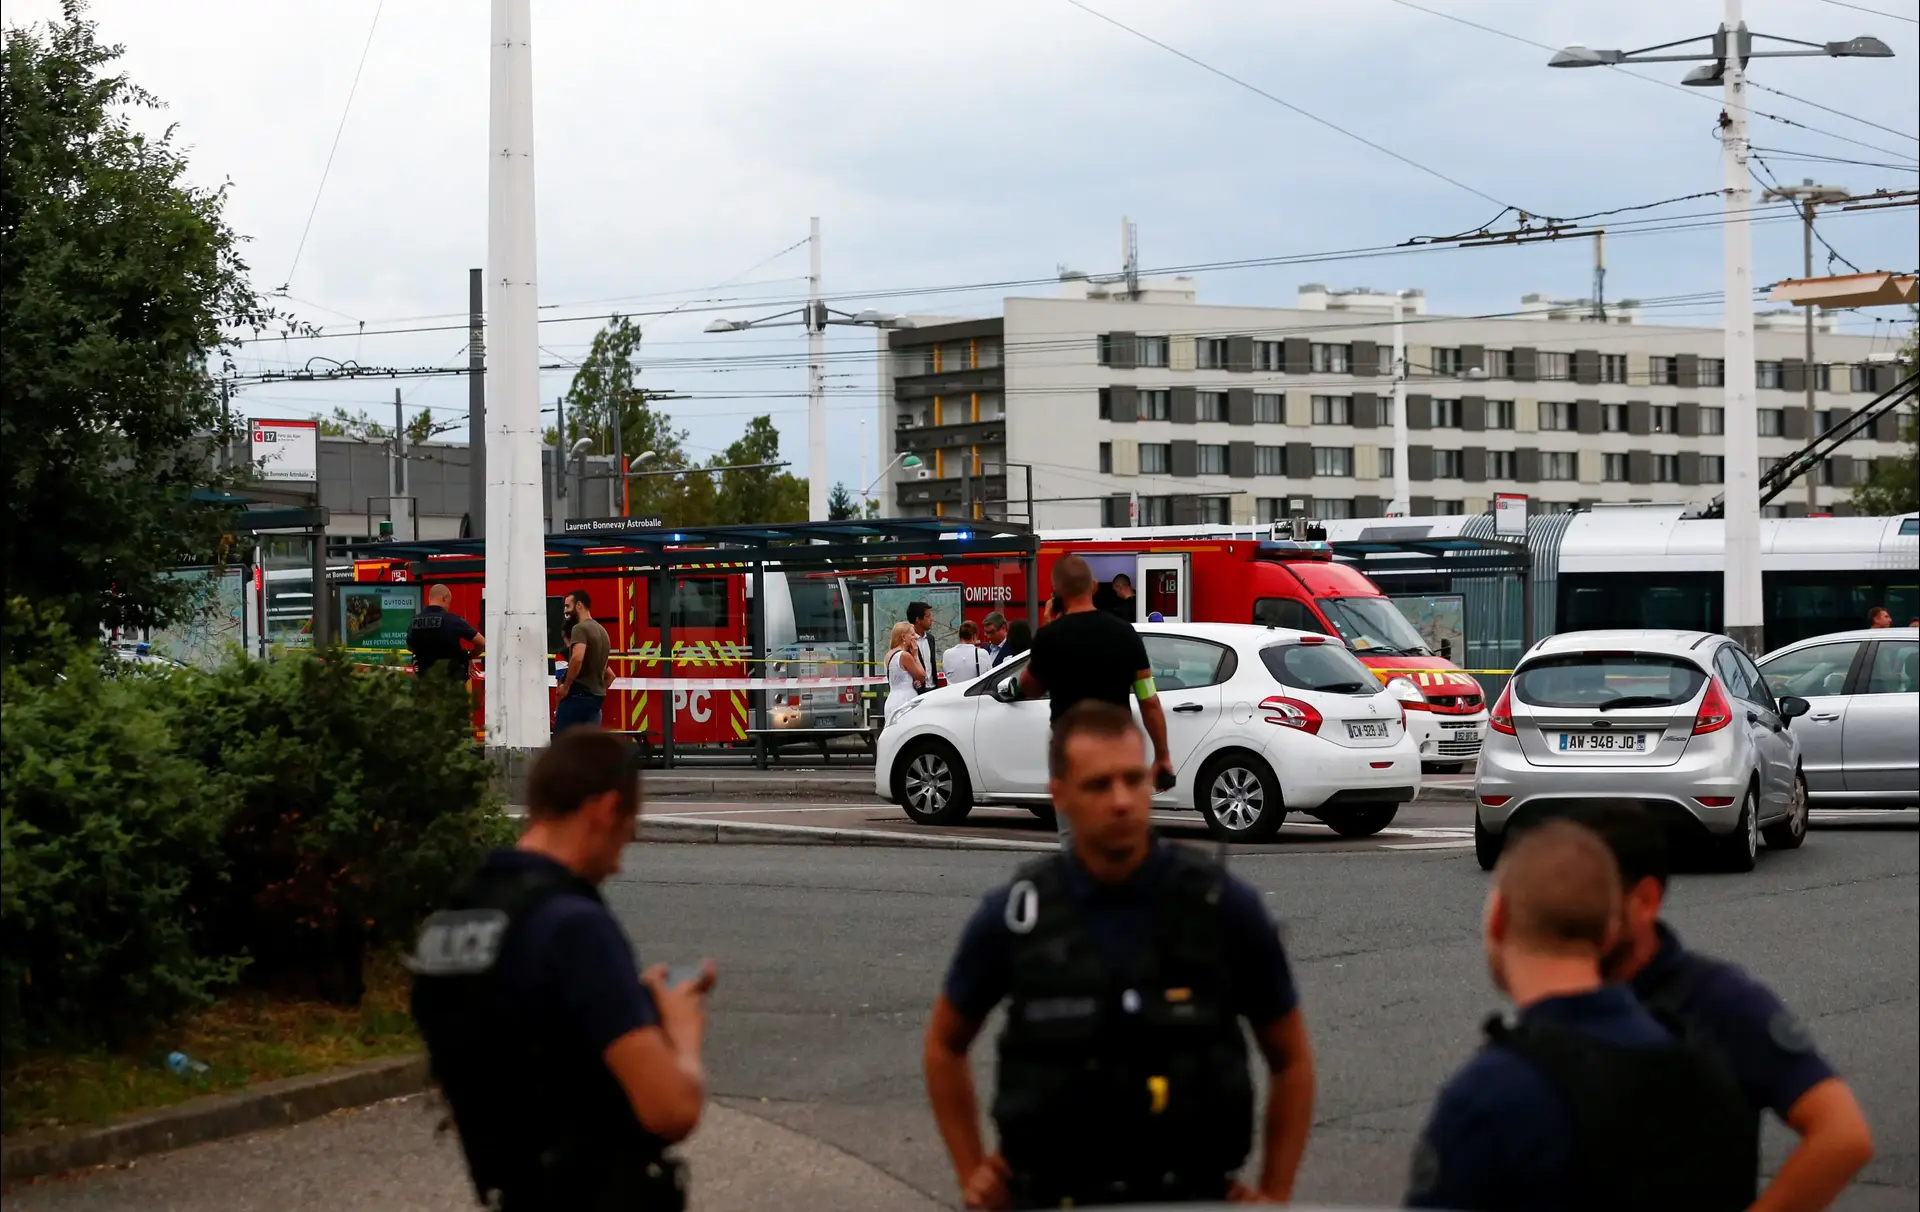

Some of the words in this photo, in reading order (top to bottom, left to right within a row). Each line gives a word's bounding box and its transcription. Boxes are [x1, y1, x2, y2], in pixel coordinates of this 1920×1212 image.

[265, 433, 275, 441] 17
[565, 522, 591, 531] Laurent
[592, 520, 626, 530] Bonnevay
[627, 518, 662, 528] Astroballe
[909, 565, 949, 584] PC
[1166, 579, 1177, 591] 18
[963, 586, 1012, 601] OMPIERS
[412, 617, 441, 628] POLICE
[672, 689, 712, 723] PC
